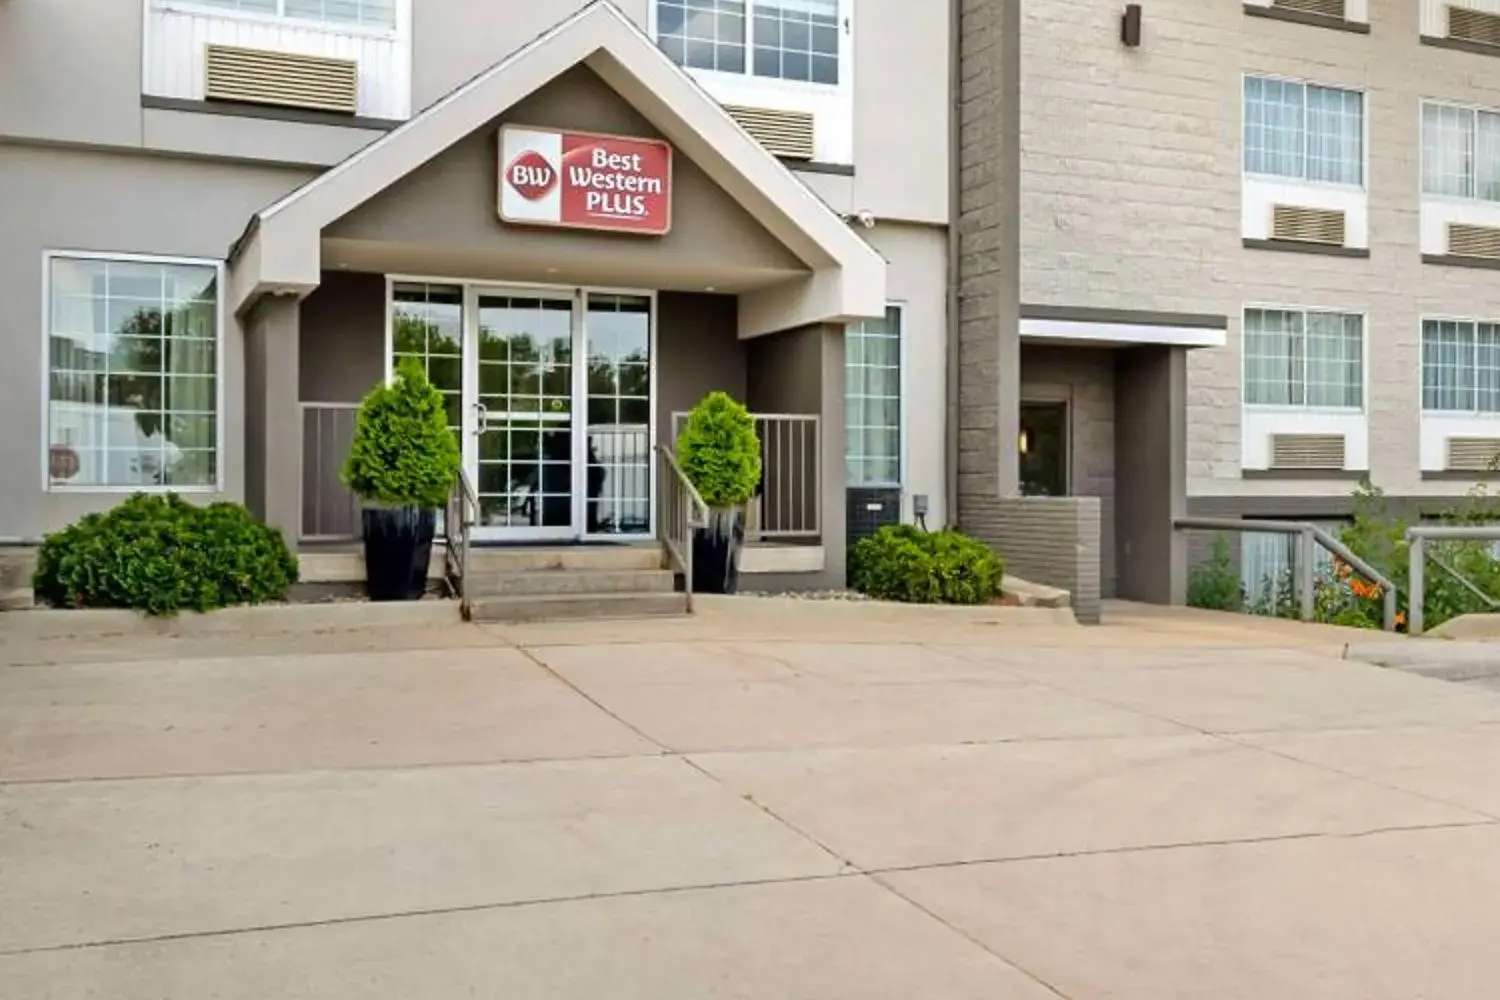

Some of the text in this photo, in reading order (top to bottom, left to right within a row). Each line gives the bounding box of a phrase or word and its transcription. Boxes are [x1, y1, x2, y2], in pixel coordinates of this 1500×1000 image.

[592, 148, 642, 172] Best
[513, 165, 551, 187] BW
[569, 166, 661, 194] Western
[586, 191, 647, 215] PLUS
